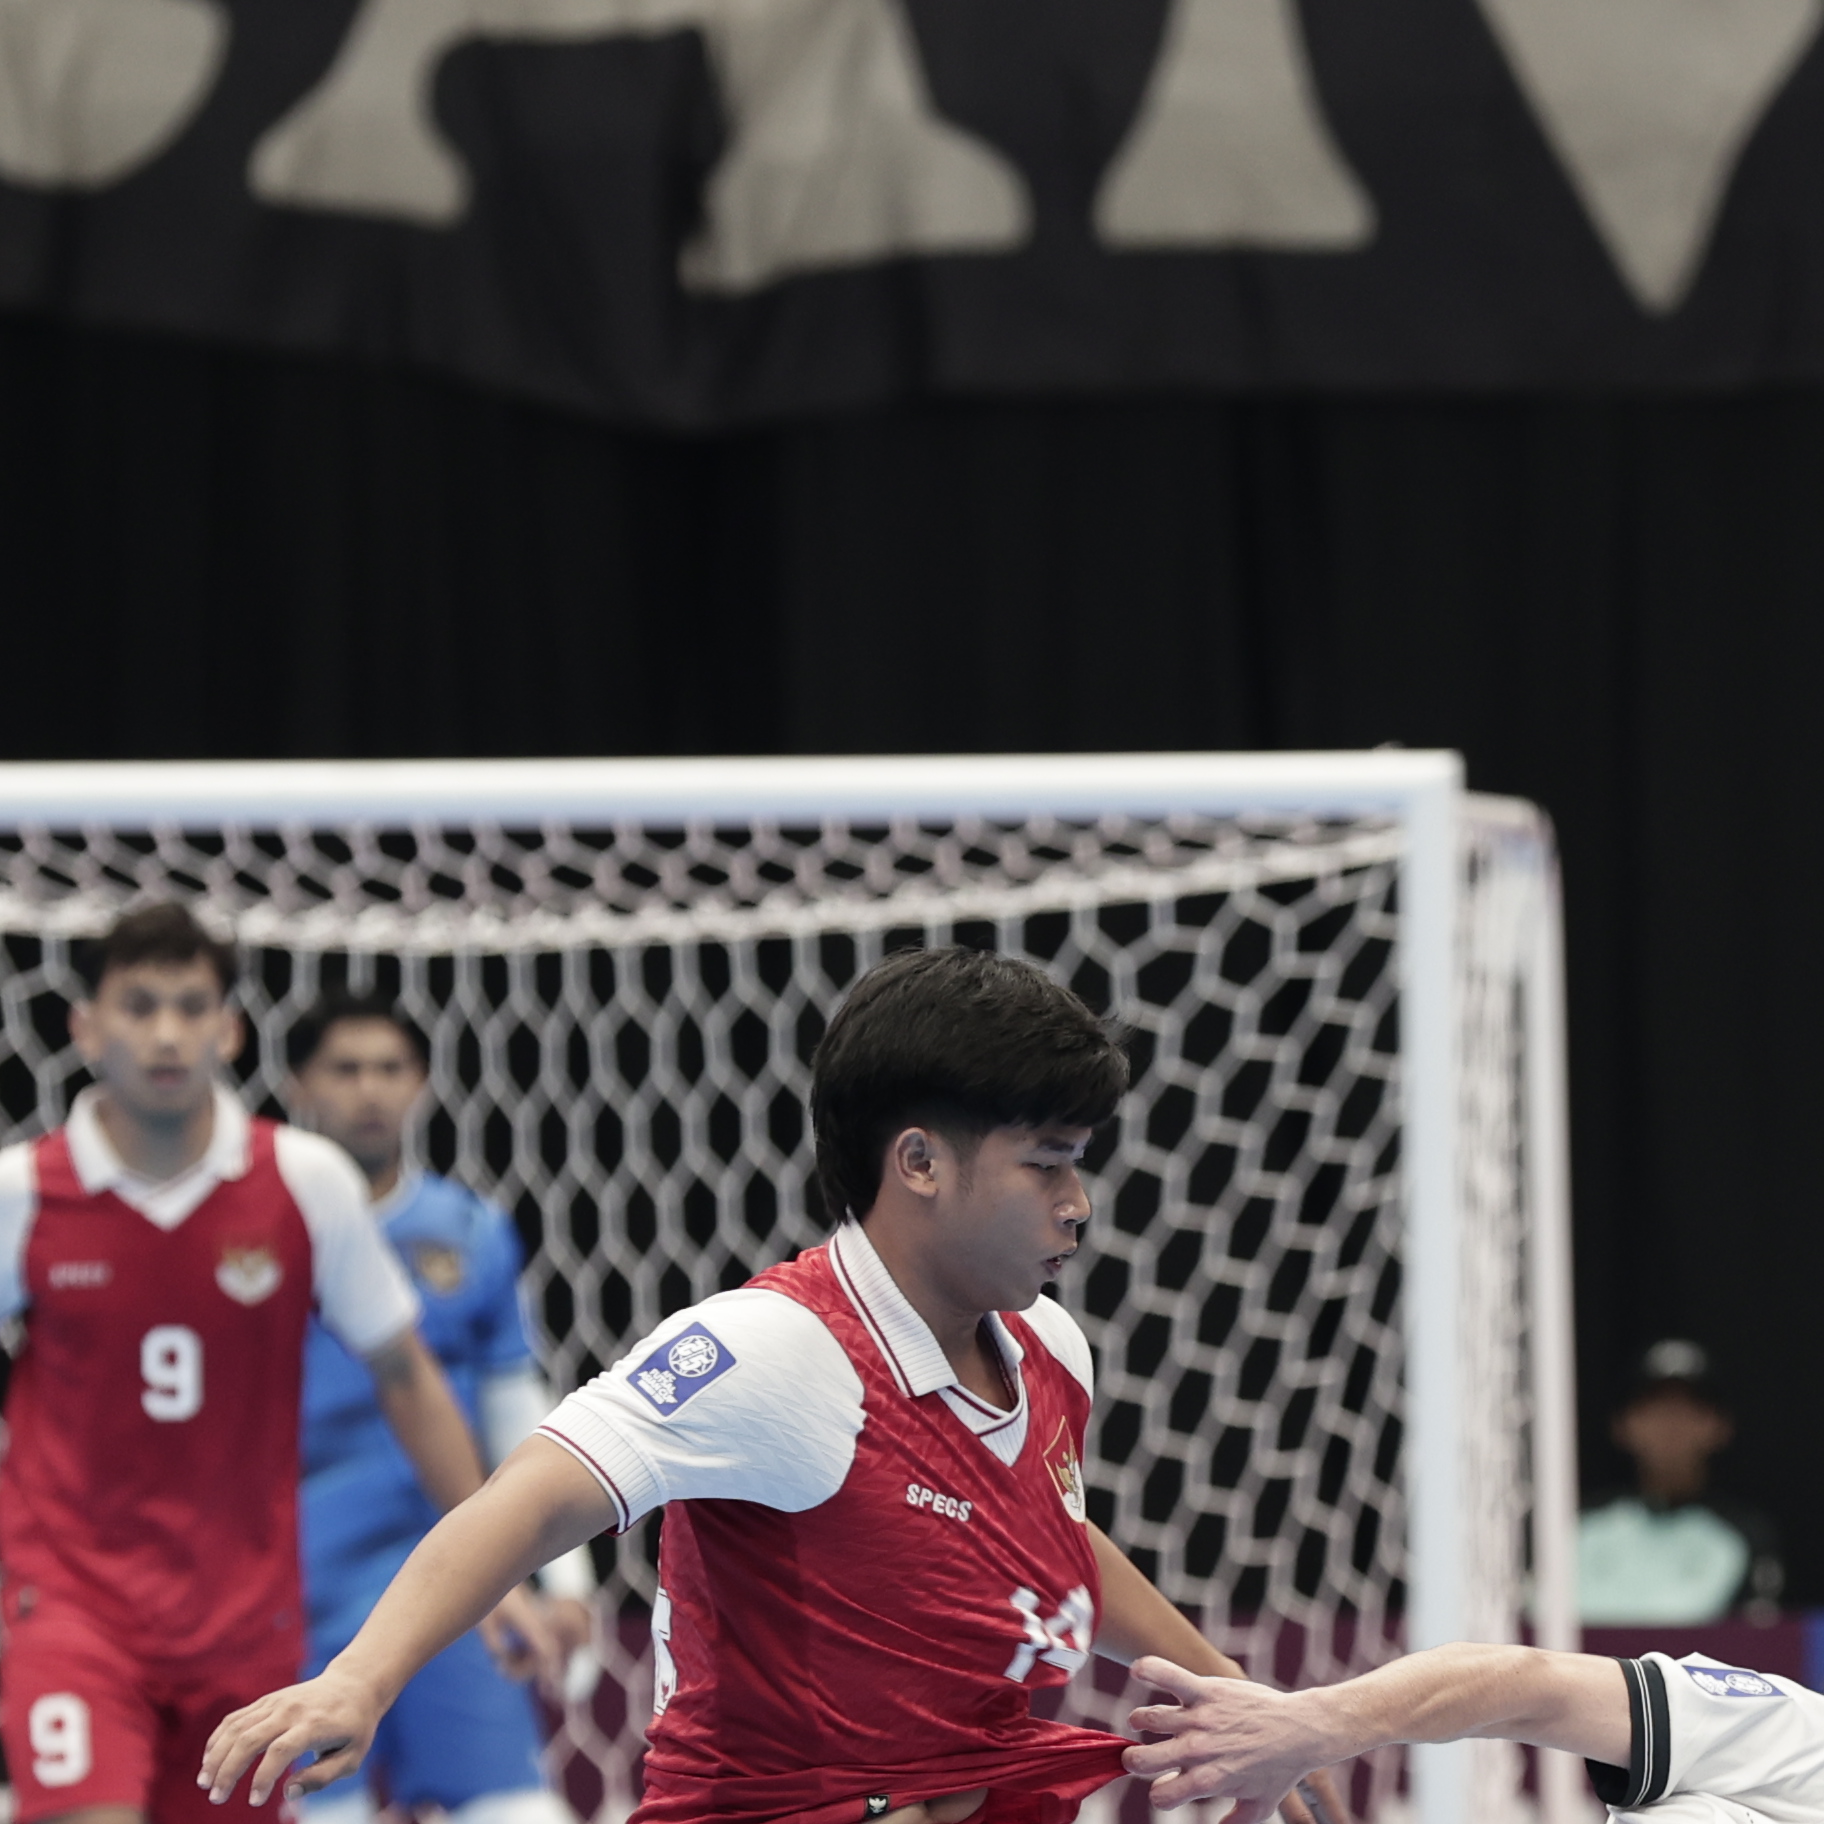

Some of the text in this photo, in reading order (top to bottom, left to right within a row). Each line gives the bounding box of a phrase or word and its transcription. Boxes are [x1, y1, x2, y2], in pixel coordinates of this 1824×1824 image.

[139, 1324, 204, 1422] 9
[906, 1483, 973, 1522] SPECS
[29, 1693, 93, 1787] 9
